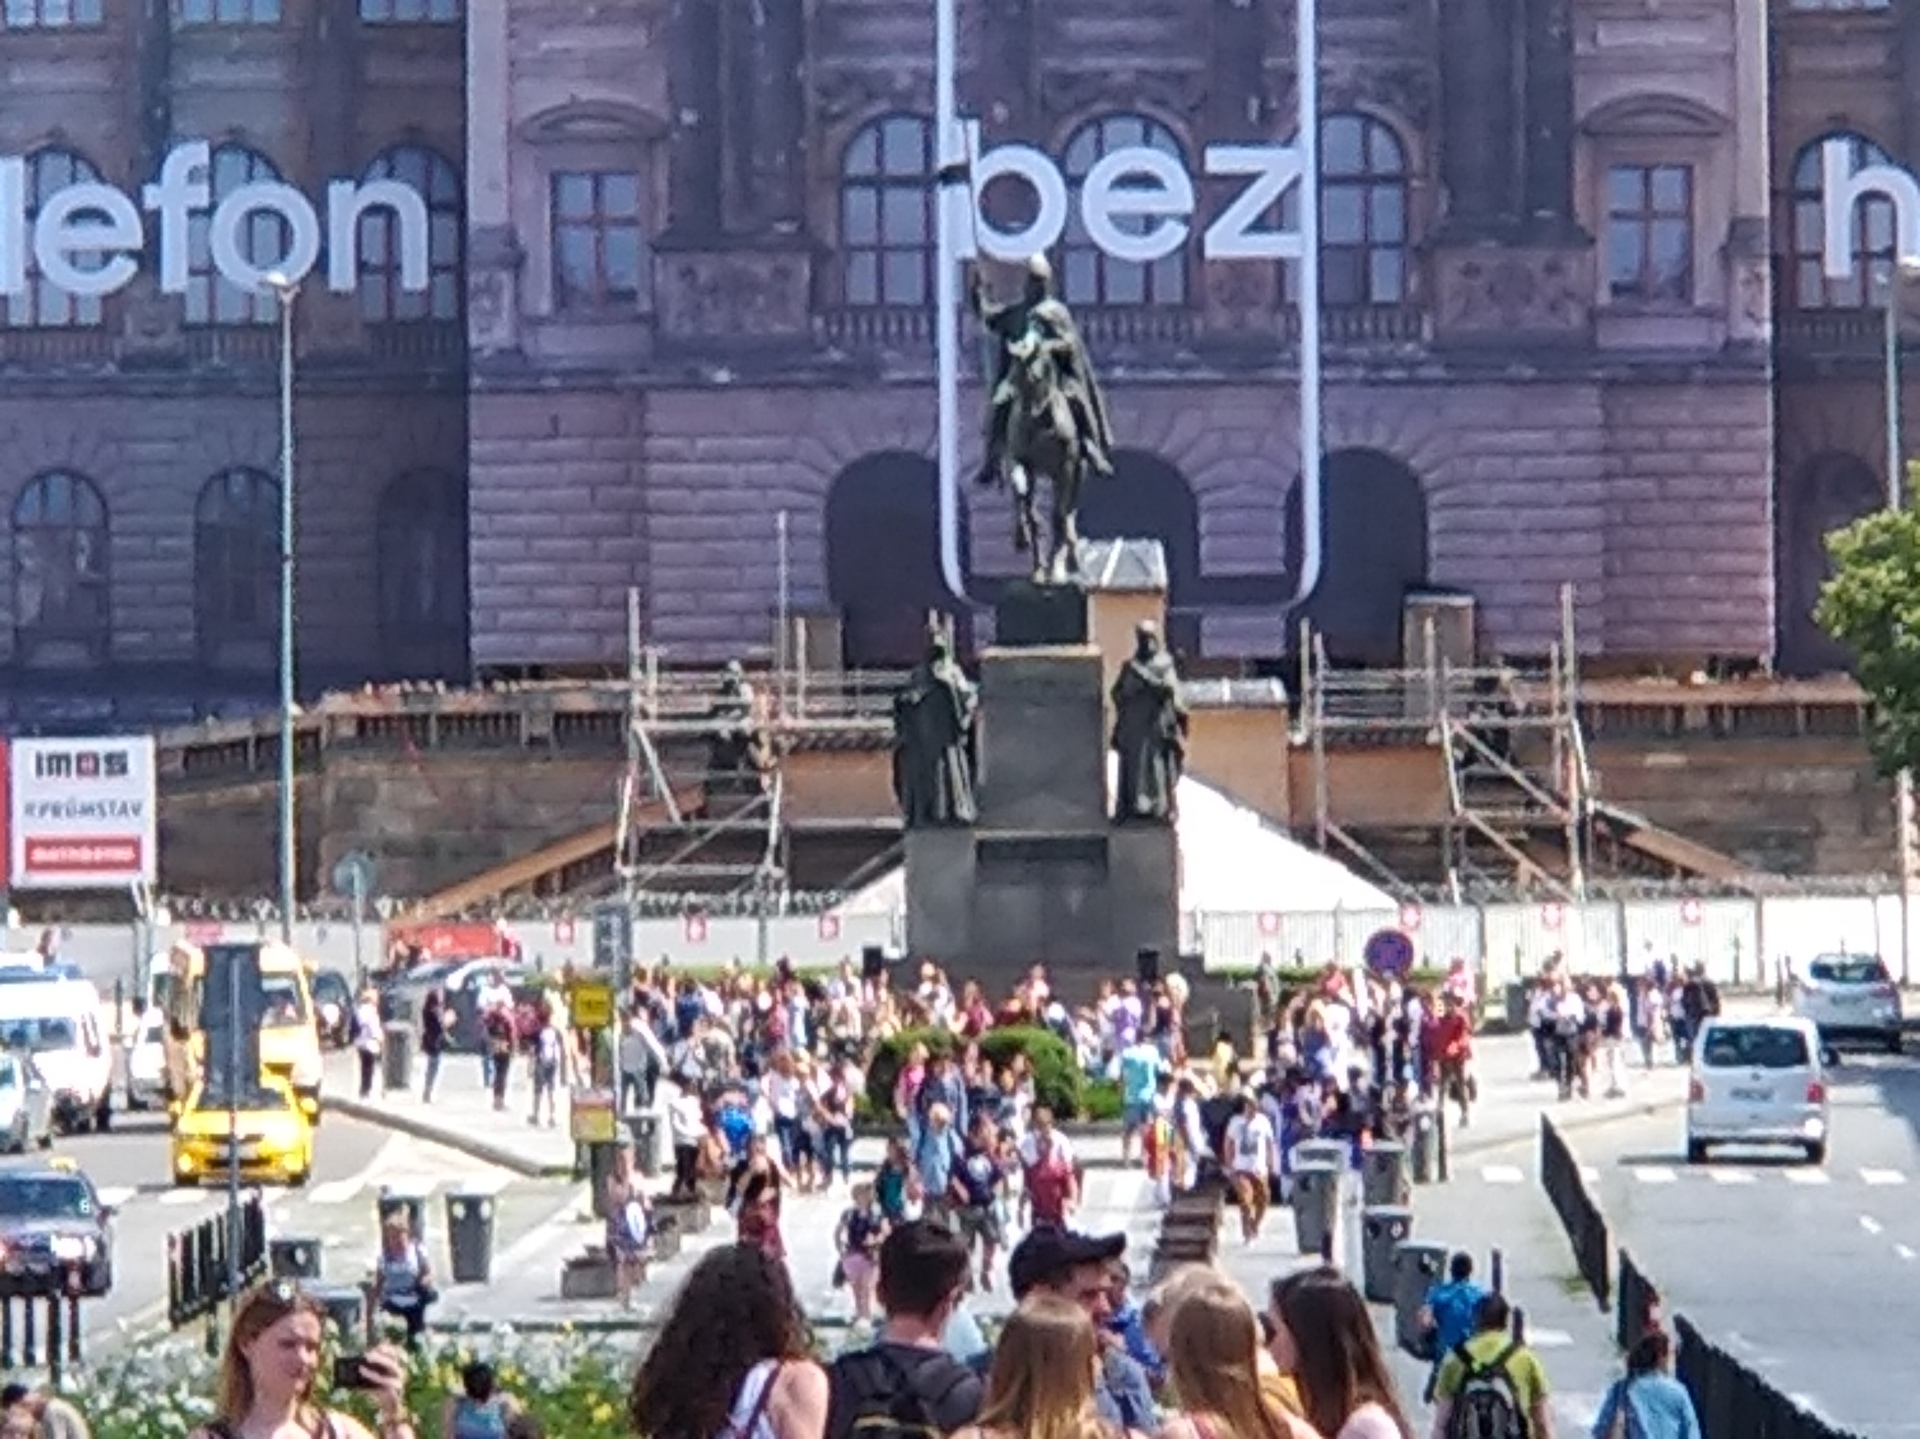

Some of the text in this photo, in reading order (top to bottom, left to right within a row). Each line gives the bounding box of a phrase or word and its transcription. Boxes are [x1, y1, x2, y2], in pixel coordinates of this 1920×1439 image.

[0, 117, 1920, 296] lefon bez h
